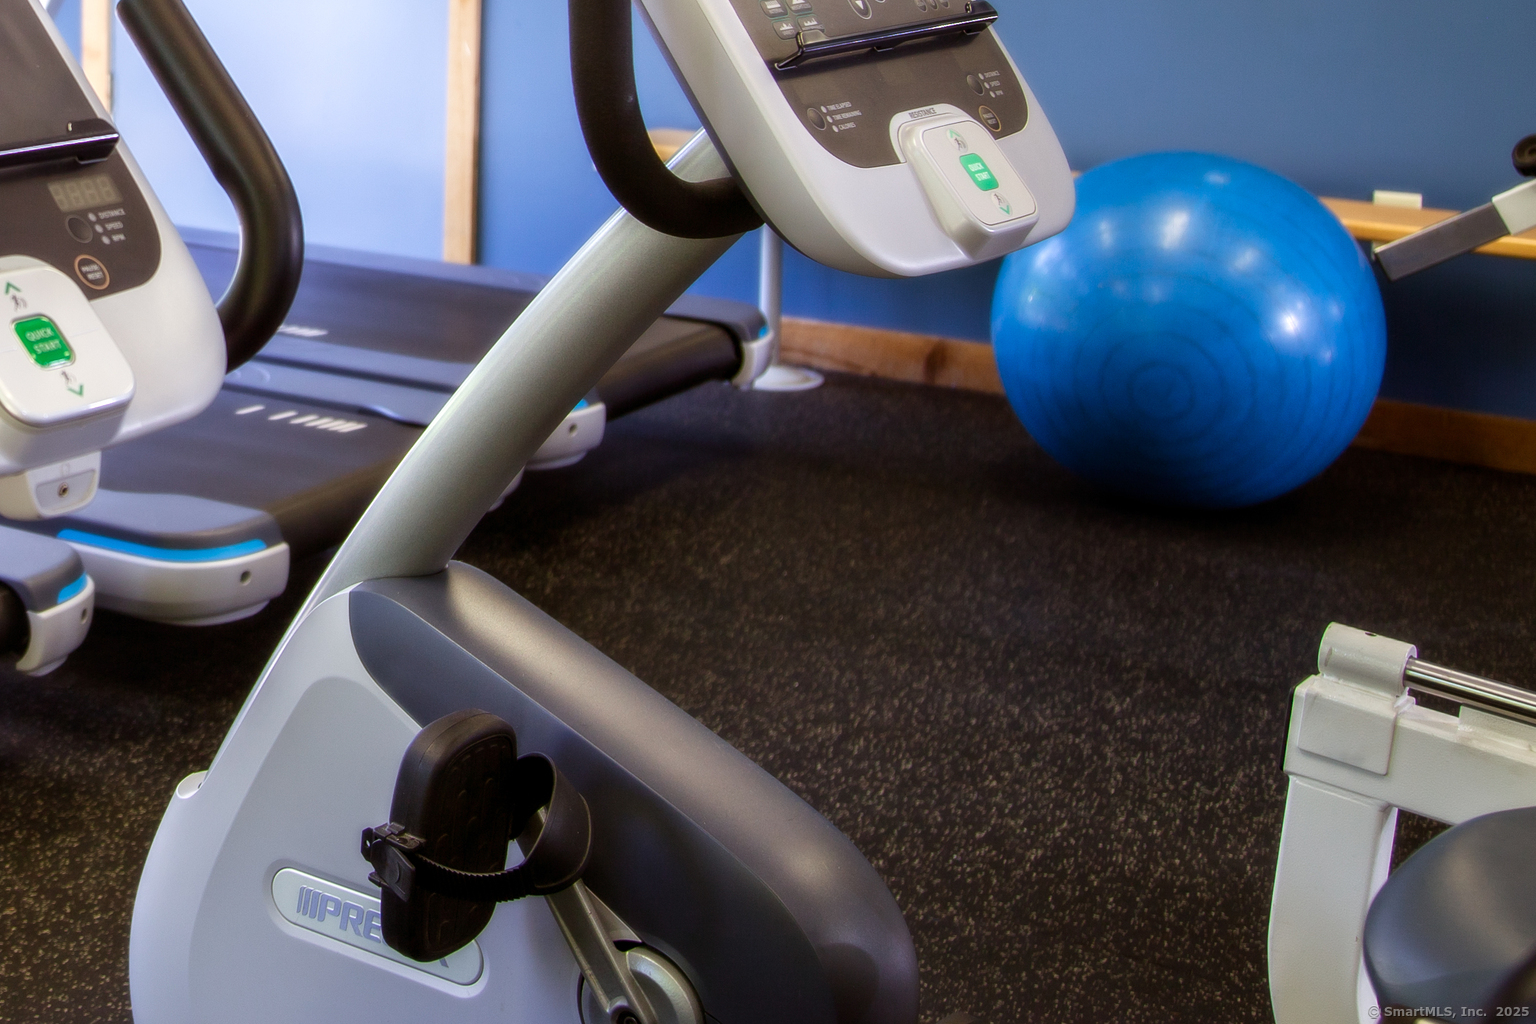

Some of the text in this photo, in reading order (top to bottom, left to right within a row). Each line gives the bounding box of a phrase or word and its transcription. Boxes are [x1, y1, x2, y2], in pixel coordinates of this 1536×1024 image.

[908, 108, 937, 119] RESISTANCE
[968, 162, 984, 172] QUICK
[975, 171, 991, 181] START
[97, 208, 126, 220] DISTANCE
[25, 327, 54, 342] QUICK
[33, 339, 62, 354] START
